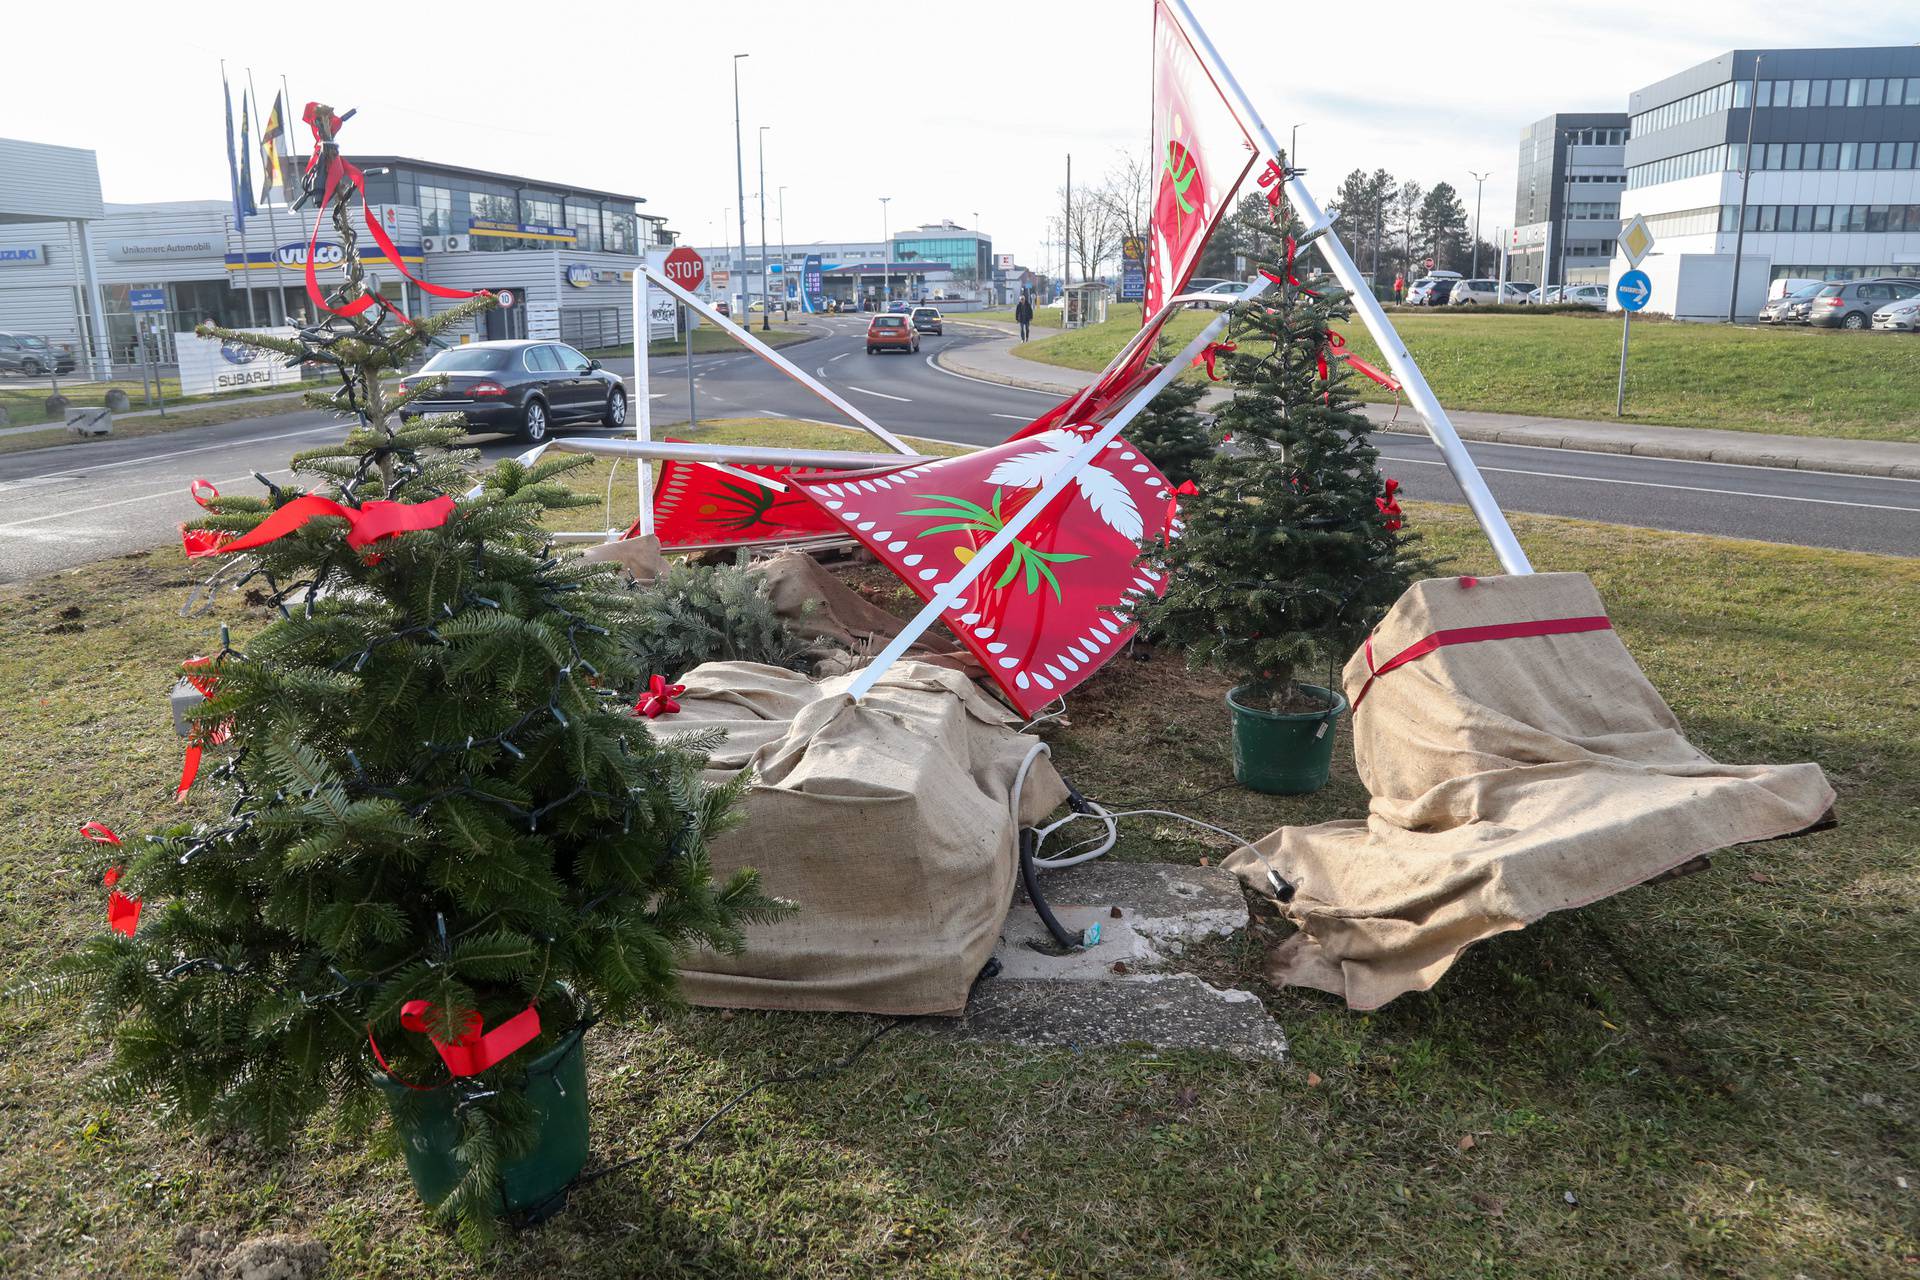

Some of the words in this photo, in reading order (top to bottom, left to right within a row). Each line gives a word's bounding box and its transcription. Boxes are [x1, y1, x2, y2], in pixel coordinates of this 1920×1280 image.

[122, 245, 165, 255] Unikomerc
[167, 242, 211, 252] Automobili
[279, 246, 343, 264] VUCO
[666, 261, 702, 279] STOP
[501, 294, 510, 304] 10
[218, 370, 271, 387] SUBARU
